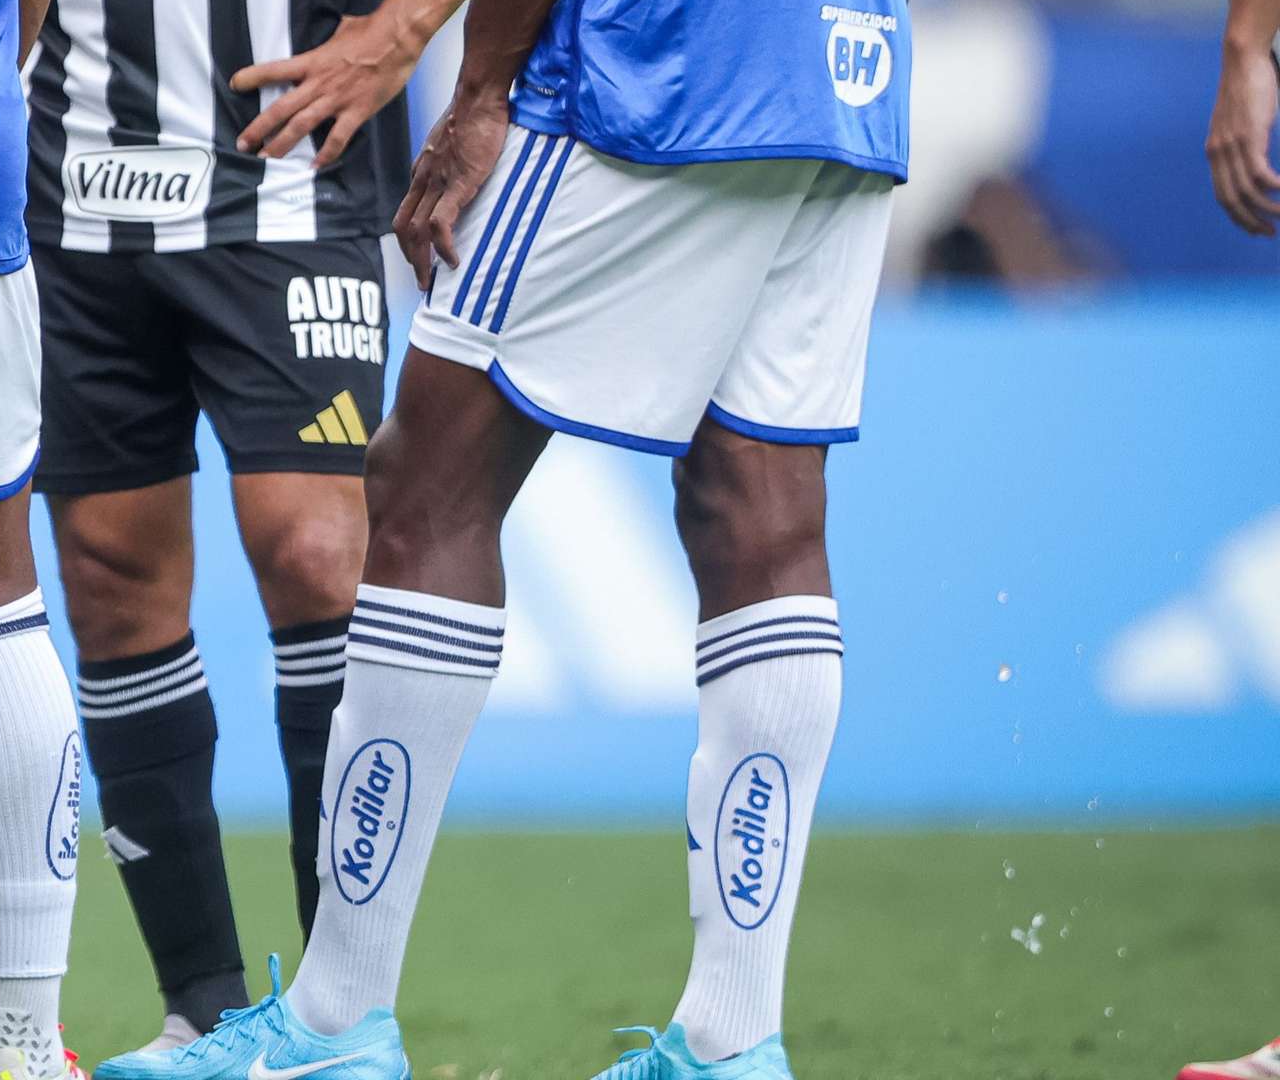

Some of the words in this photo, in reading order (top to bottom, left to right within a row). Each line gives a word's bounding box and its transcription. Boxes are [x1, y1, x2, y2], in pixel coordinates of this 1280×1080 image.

[835, 36, 881, 86] BH
[77, 159, 191, 203] Vilma
[286, 276, 382, 326] AUTO
[289, 322, 384, 366] TRUCK
[340, 750, 396, 886] Kodilar
[729, 768, 775, 908] Kodilar
